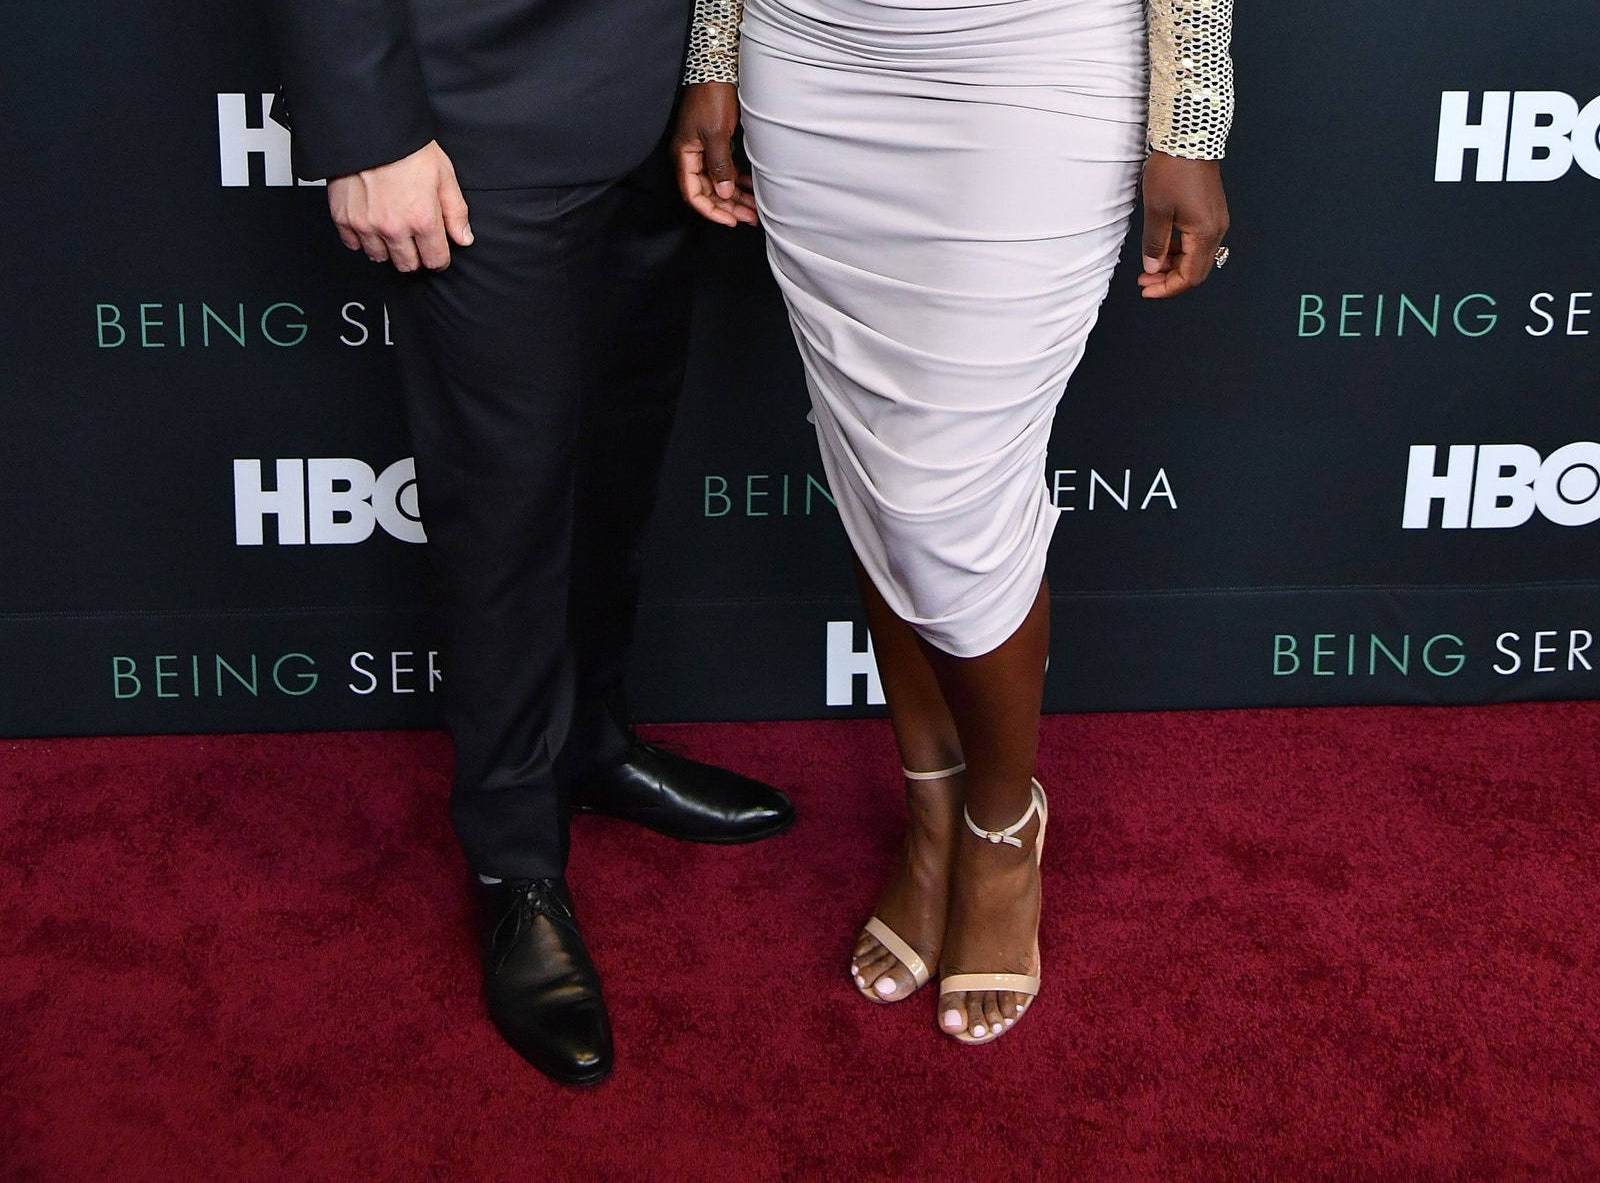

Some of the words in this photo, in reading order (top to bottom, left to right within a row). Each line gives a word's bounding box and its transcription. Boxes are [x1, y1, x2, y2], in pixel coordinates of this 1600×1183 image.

[217, 92, 327, 187] H
[96, 302, 308, 348] BEING
[1298, 293, 1498, 337] BEING
[1524, 292, 1593, 337] SE
[1401, 441, 1600, 529] HBO
[112, 653, 318, 699] BEING
[1273, 633, 1466, 677] BEING
[1492, 629, 1593, 675] SER
